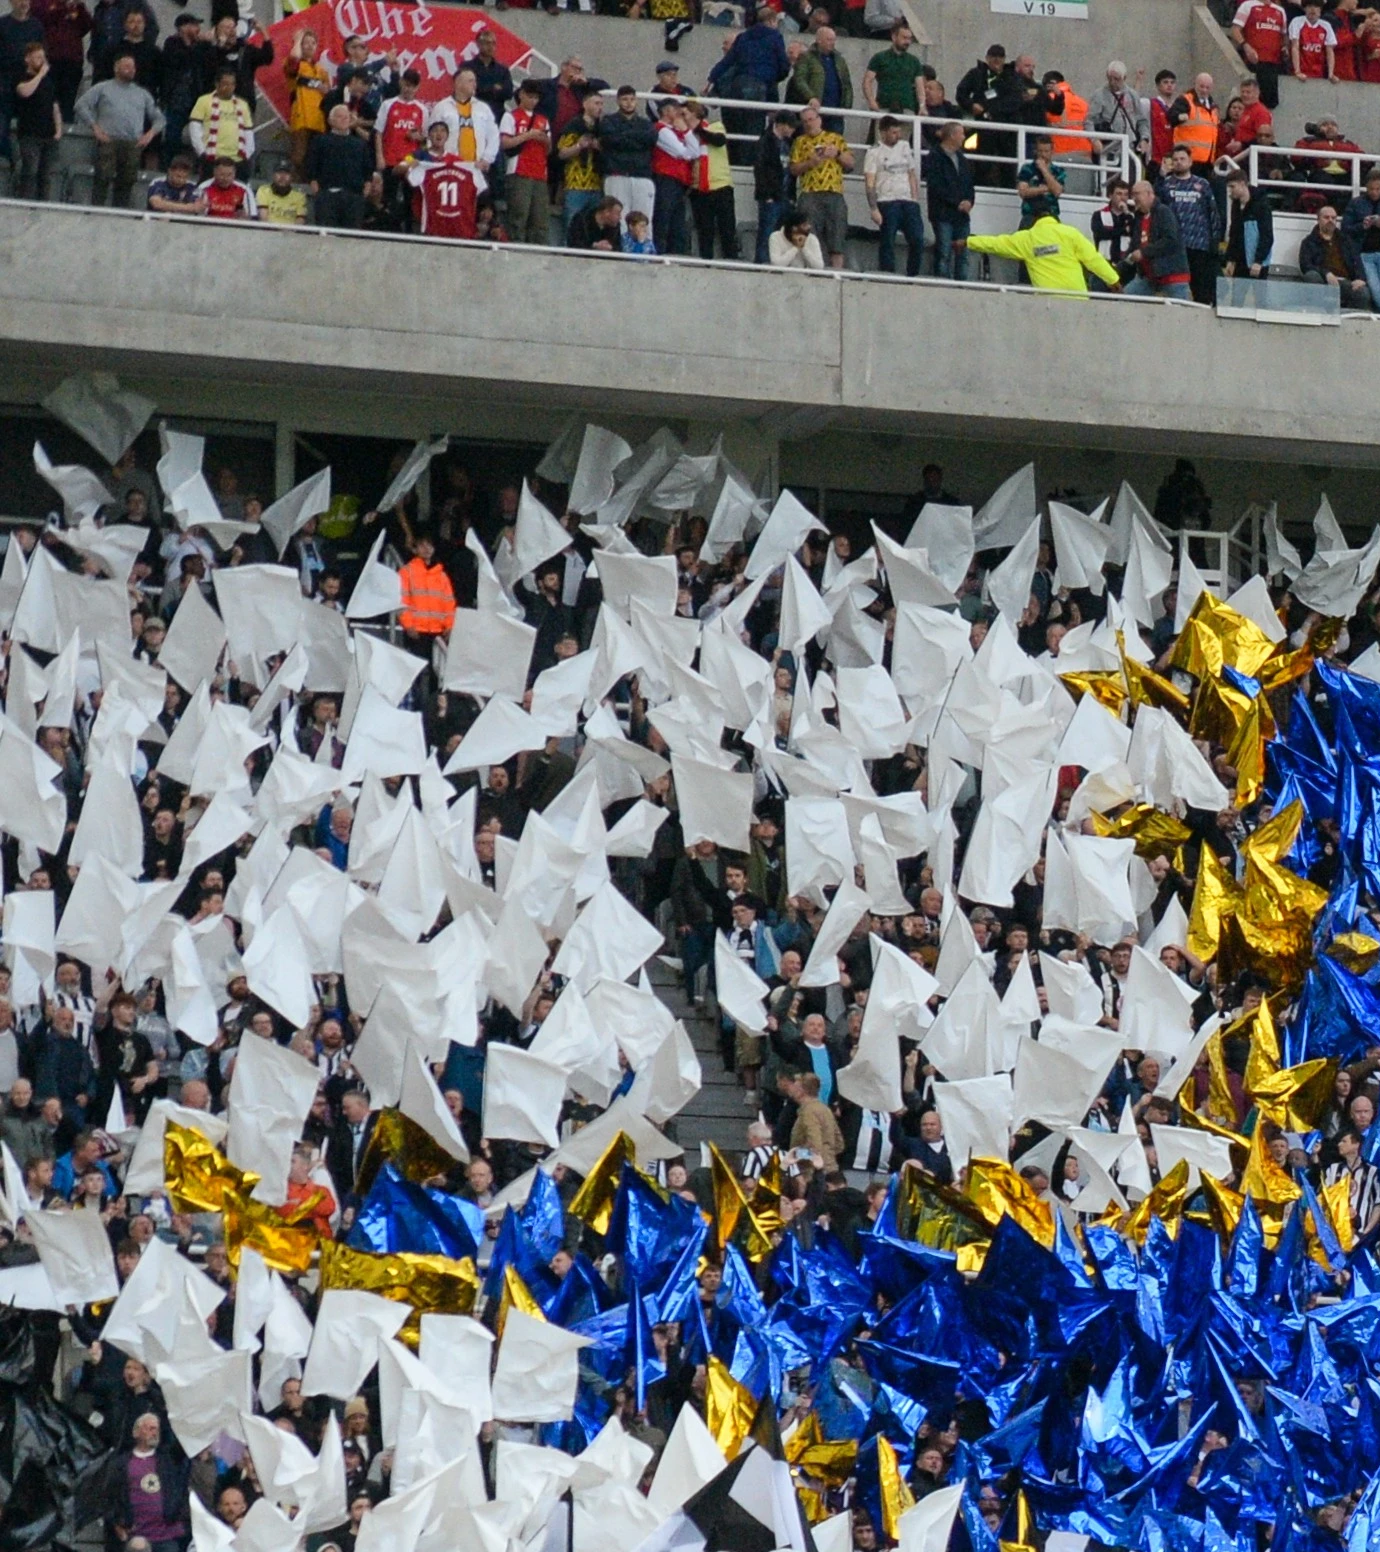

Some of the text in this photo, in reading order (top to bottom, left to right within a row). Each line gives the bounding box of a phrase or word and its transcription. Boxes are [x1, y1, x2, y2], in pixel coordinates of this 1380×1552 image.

[1024, 2, 1056, 15] V 19
[1302, 44, 1322, 53] JVC
[394, 119, 416, 130] JVC
[437, 181, 459, 207] 11
